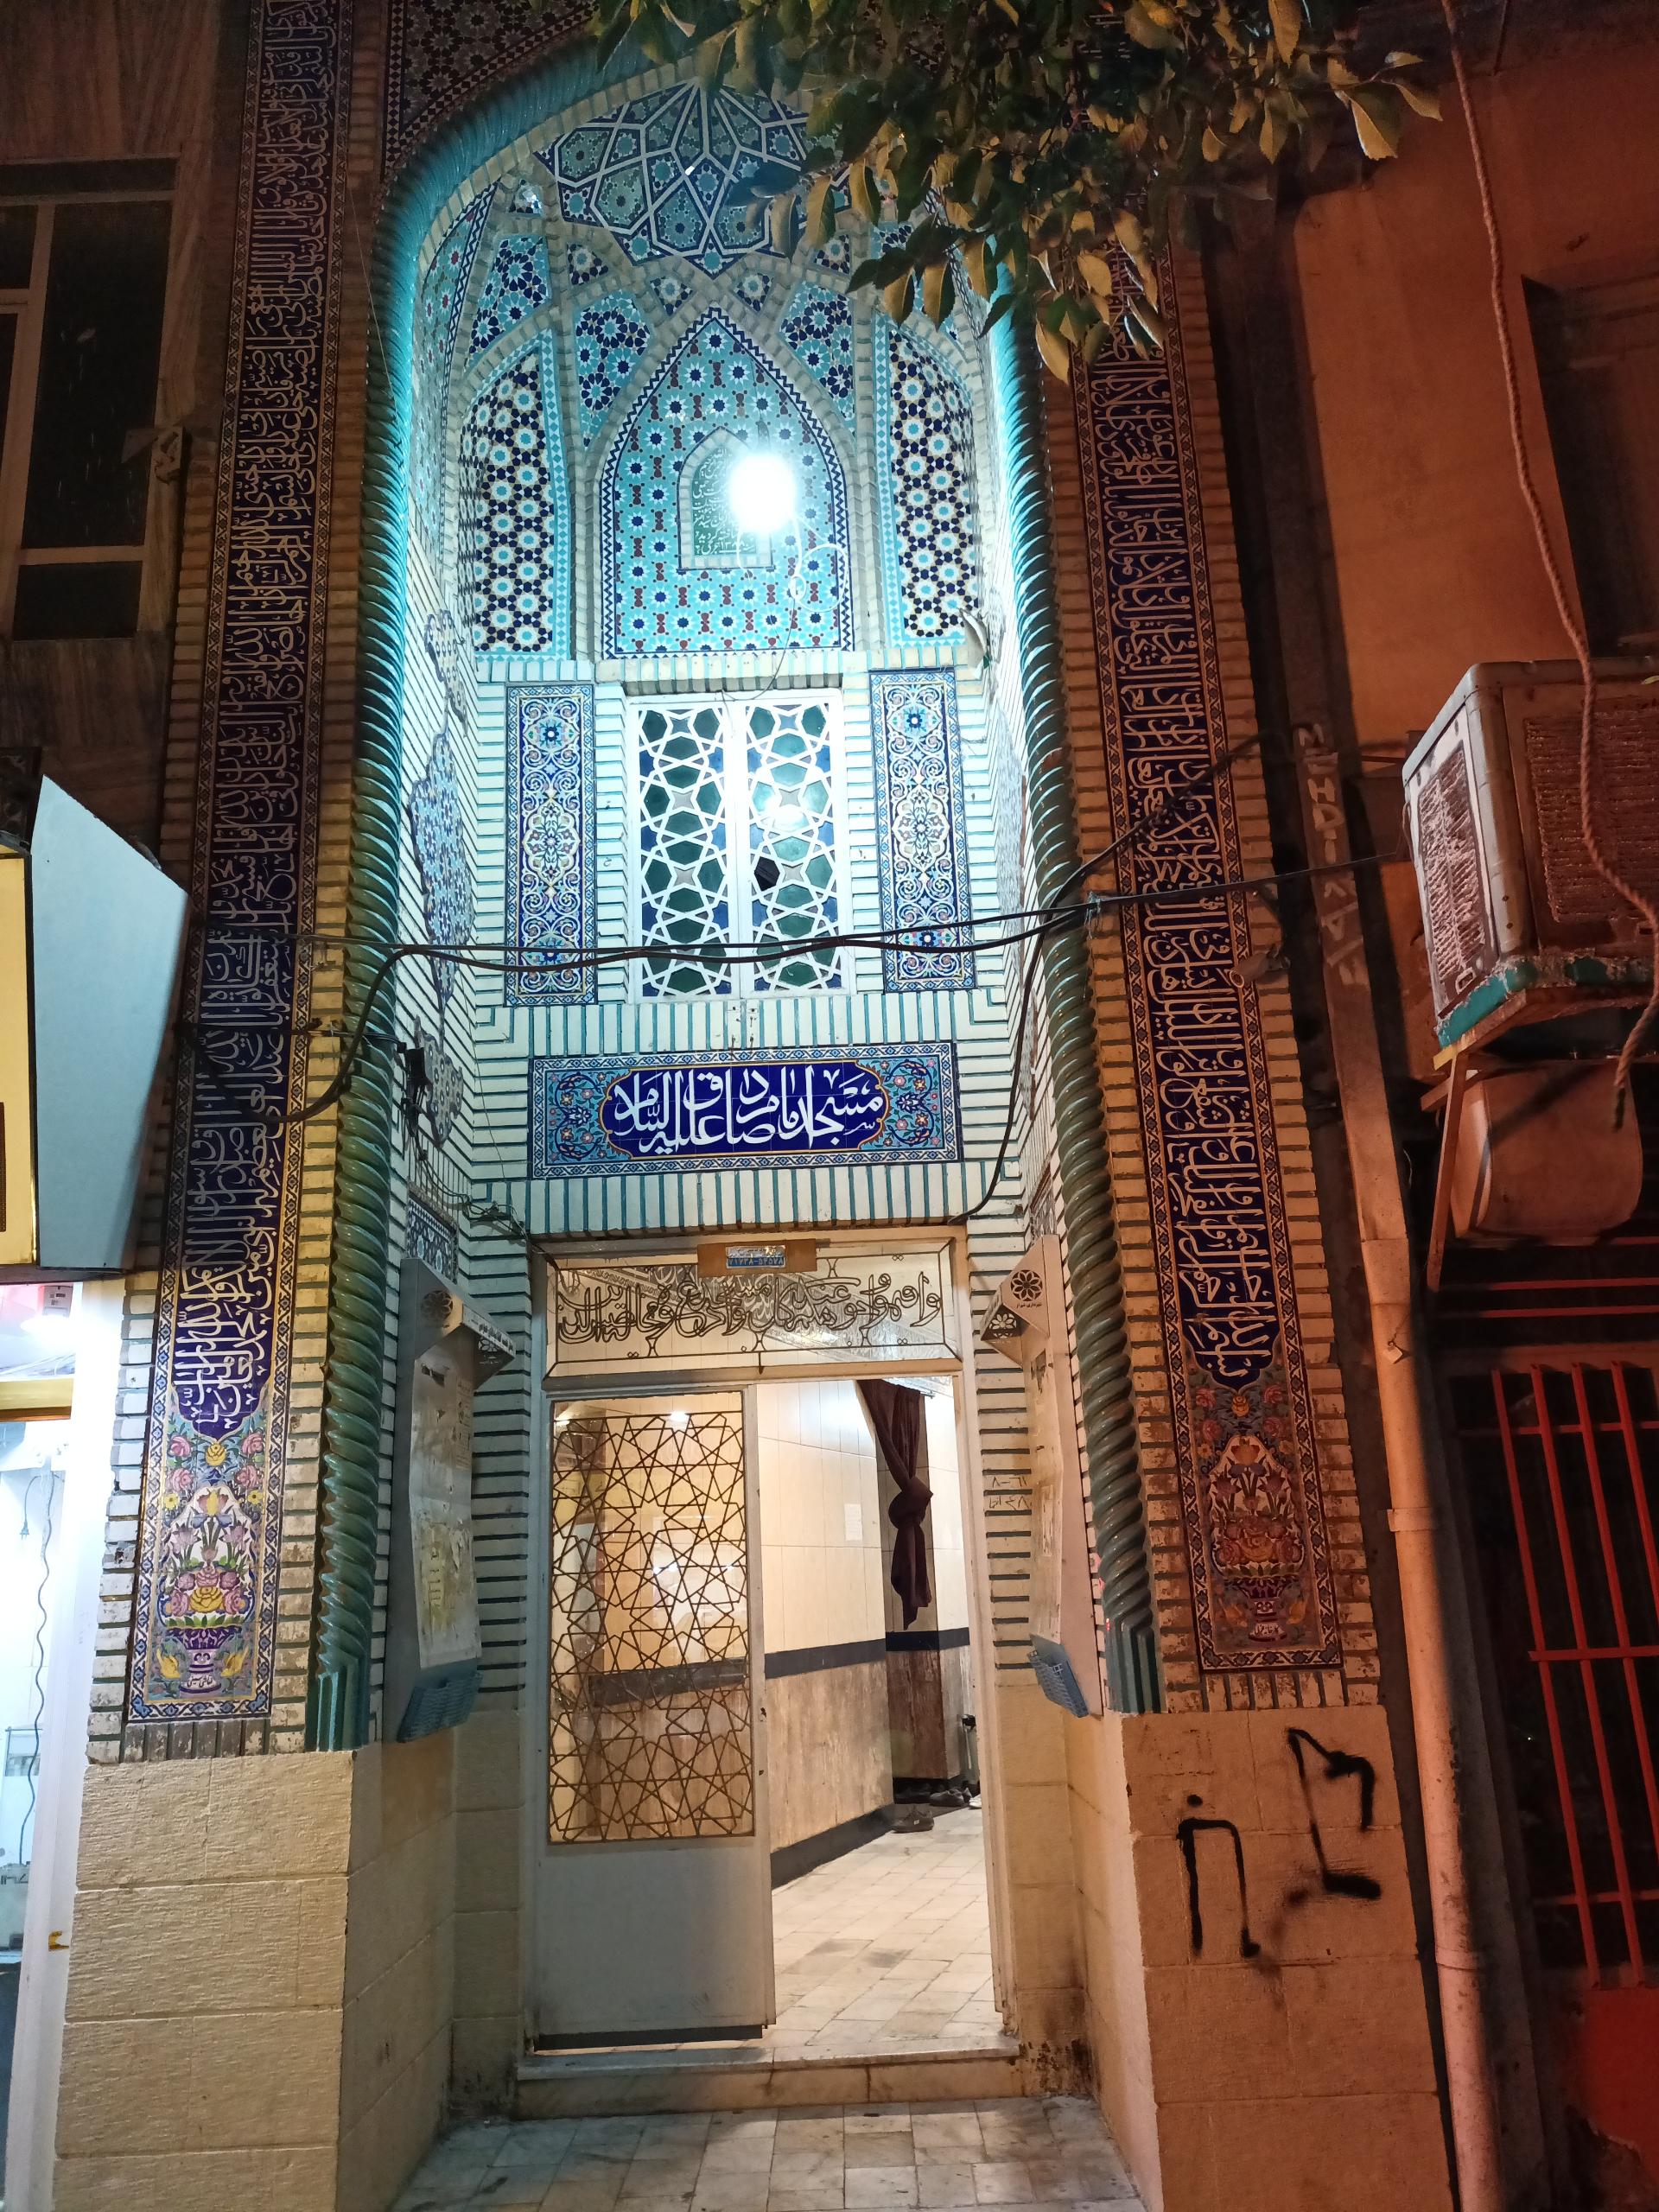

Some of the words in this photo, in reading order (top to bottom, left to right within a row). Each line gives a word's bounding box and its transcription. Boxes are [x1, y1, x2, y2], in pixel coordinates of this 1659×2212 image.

[683, 1068, 776, 1144] صادق
[736, 1065, 815, 1150] امام
[779, 1069, 884, 1145] مسجد
